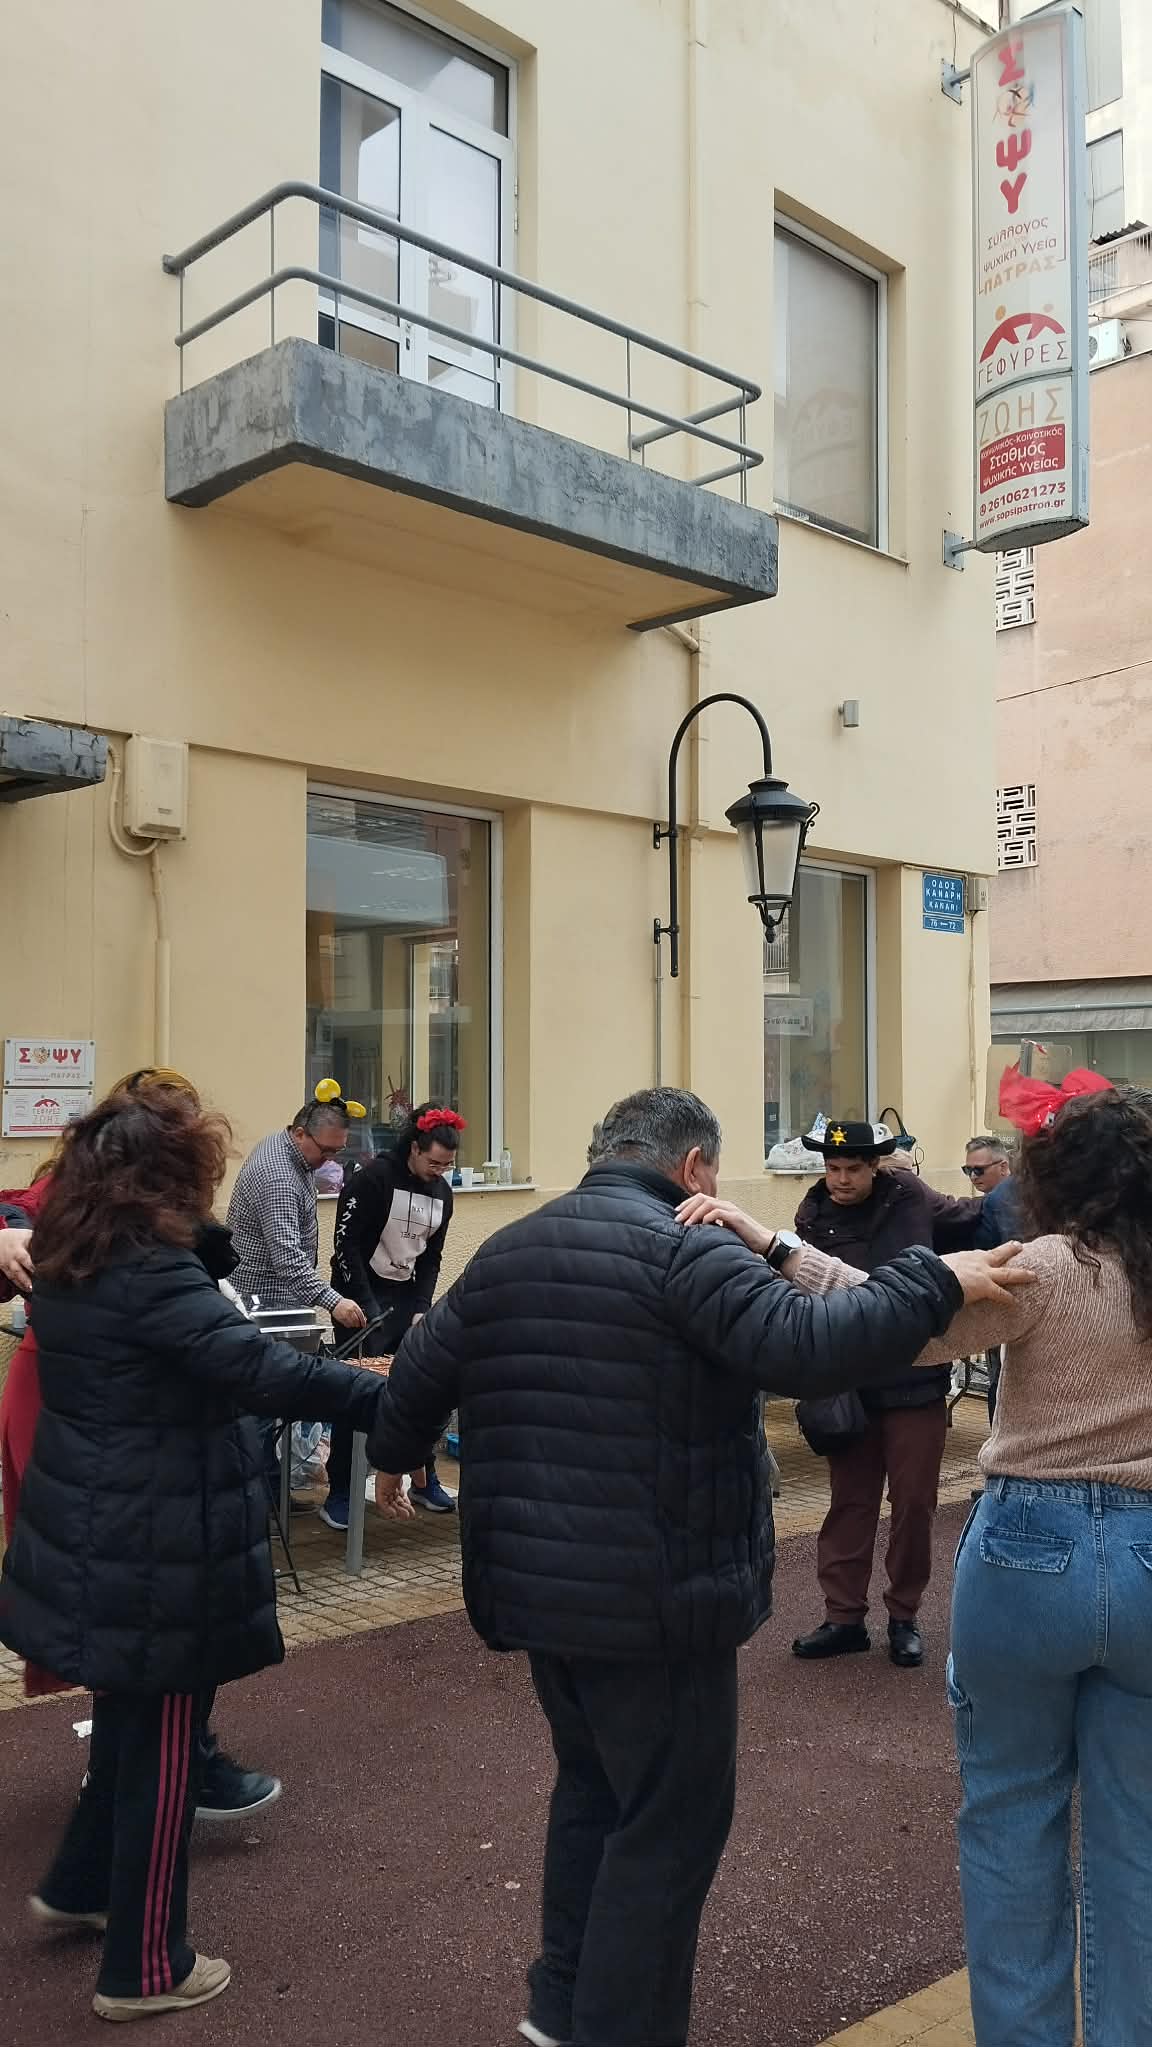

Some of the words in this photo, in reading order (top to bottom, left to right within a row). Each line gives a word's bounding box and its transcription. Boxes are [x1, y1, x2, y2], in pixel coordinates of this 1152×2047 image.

[983, 256, 1056, 295] ΠΑΤΡΑΣ
[978, 340, 1068, 388] ΓΕΦΥΡΕΣ
[979, 387, 1064, 446] ΖΩΗΣ
[990, 441, 1047, 470] Σταθμός
[1020, 456, 1059, 473] Υγείας
[988, 482, 1066, 512] 2610621273
[980, 499, 1066, 529] www.sopsipatron.gr
[925, 887, 961, 901] ΚΑΝΑΡΗ
[931, 879, 955, 891] ΟΔΟΣ
[949, 921, 956, 930] 72
